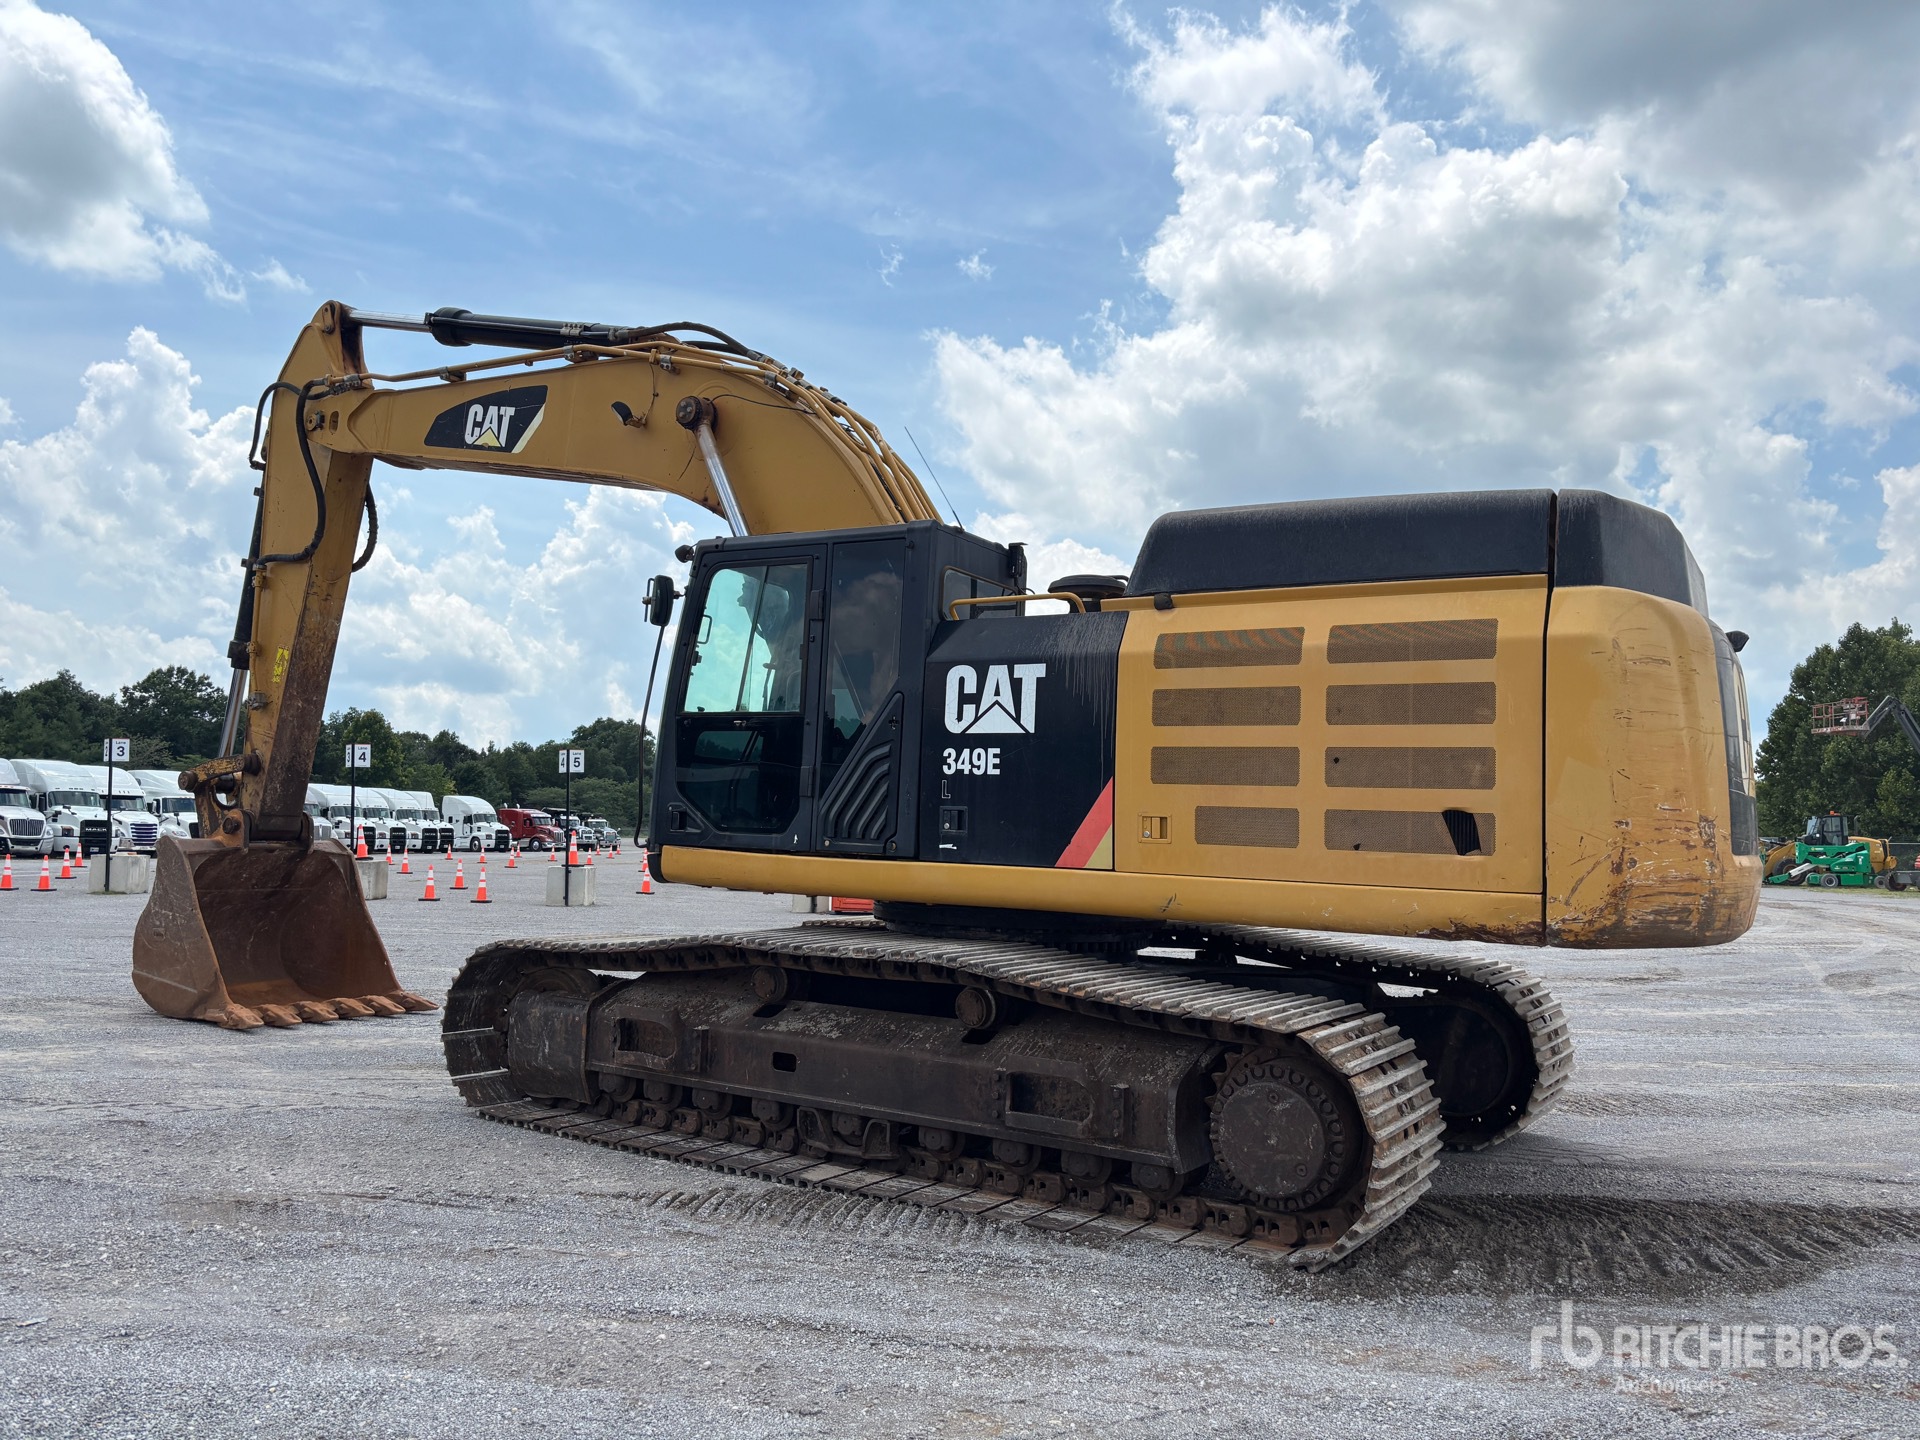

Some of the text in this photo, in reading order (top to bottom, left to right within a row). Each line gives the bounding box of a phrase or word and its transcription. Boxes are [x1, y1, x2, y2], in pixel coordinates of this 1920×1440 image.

[464, 403, 516, 448] CAT
[944, 663, 1047, 734] CAT
[116, 745, 125, 757] 3
[358, 751, 367, 763] 4
[560, 757, 565, 768] 4
[573, 757, 581, 768] 5
[942, 747, 1001, 776] 349E
[941, 779, 952, 799] L
